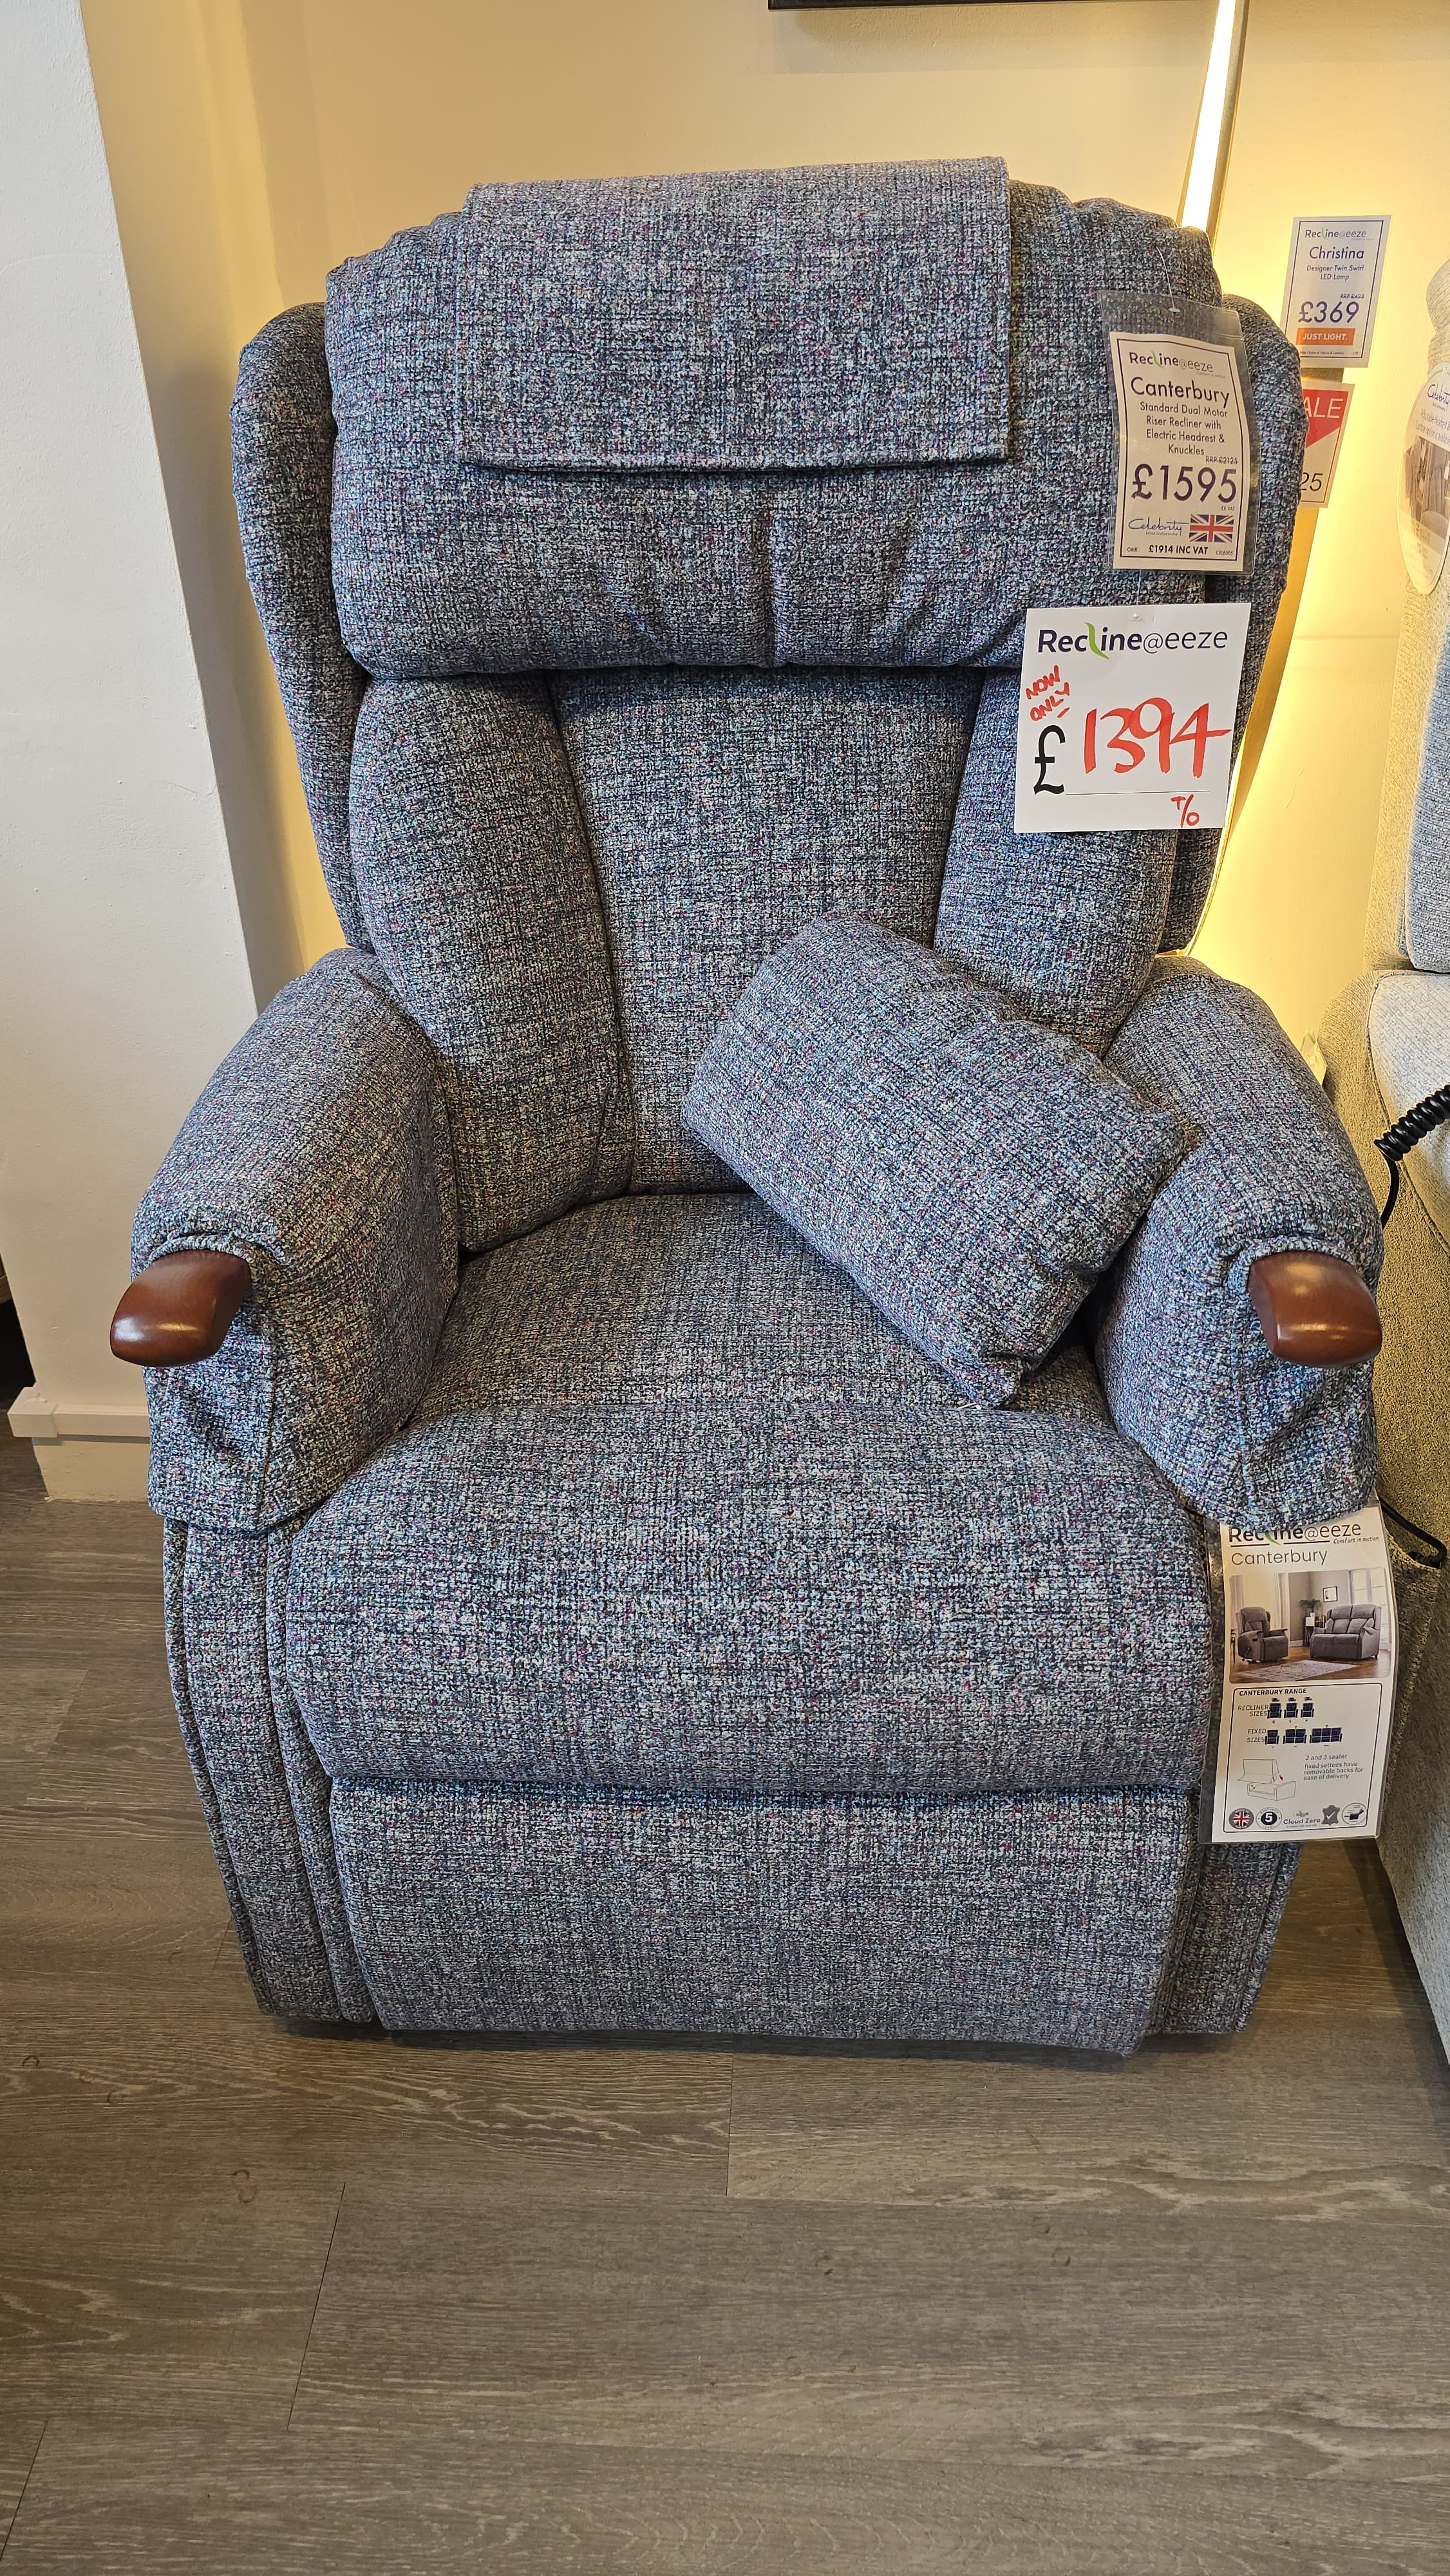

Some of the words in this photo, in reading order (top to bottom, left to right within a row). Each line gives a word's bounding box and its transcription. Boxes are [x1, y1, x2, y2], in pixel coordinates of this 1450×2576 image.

[1309, 245, 1364, 259] Christina
[1298, 301, 1359, 323] £369
[1129, 350, 1214, 374] Recline@eeze
[1131, 377, 1230, 409] Canterbury
[1140, 401, 1178, 413] Standard
[1182, 404, 1201, 415] Dual
[1203, 407, 1228, 418] Motor
[1303, 397, 1344, 419] ALE
[1146, 415, 1167, 426] Riser
[1169, 417, 1202, 429] Recliner
[1204, 420, 1221, 430] with
[1147, 429, 1176, 440] Electric
[1179, 431, 1216, 443] Headrest
[1218, 434, 1225, 443] &
[1168, 444, 1205, 455] Knuckles
[1131, 463, 1237, 503] £1595
[1301, 472, 1323, 491] 25
[1128, 517, 1190, 536] Celebrity
[1038, 622, 1227, 659] Recline@eeze
[1026, 665, 1060, 699] NOW
[1030, 682, 1070, 722] ONLY
[1231, 1549, 1328, 1566] Canterbury
[1265, 1813, 1273, 1822] 5
